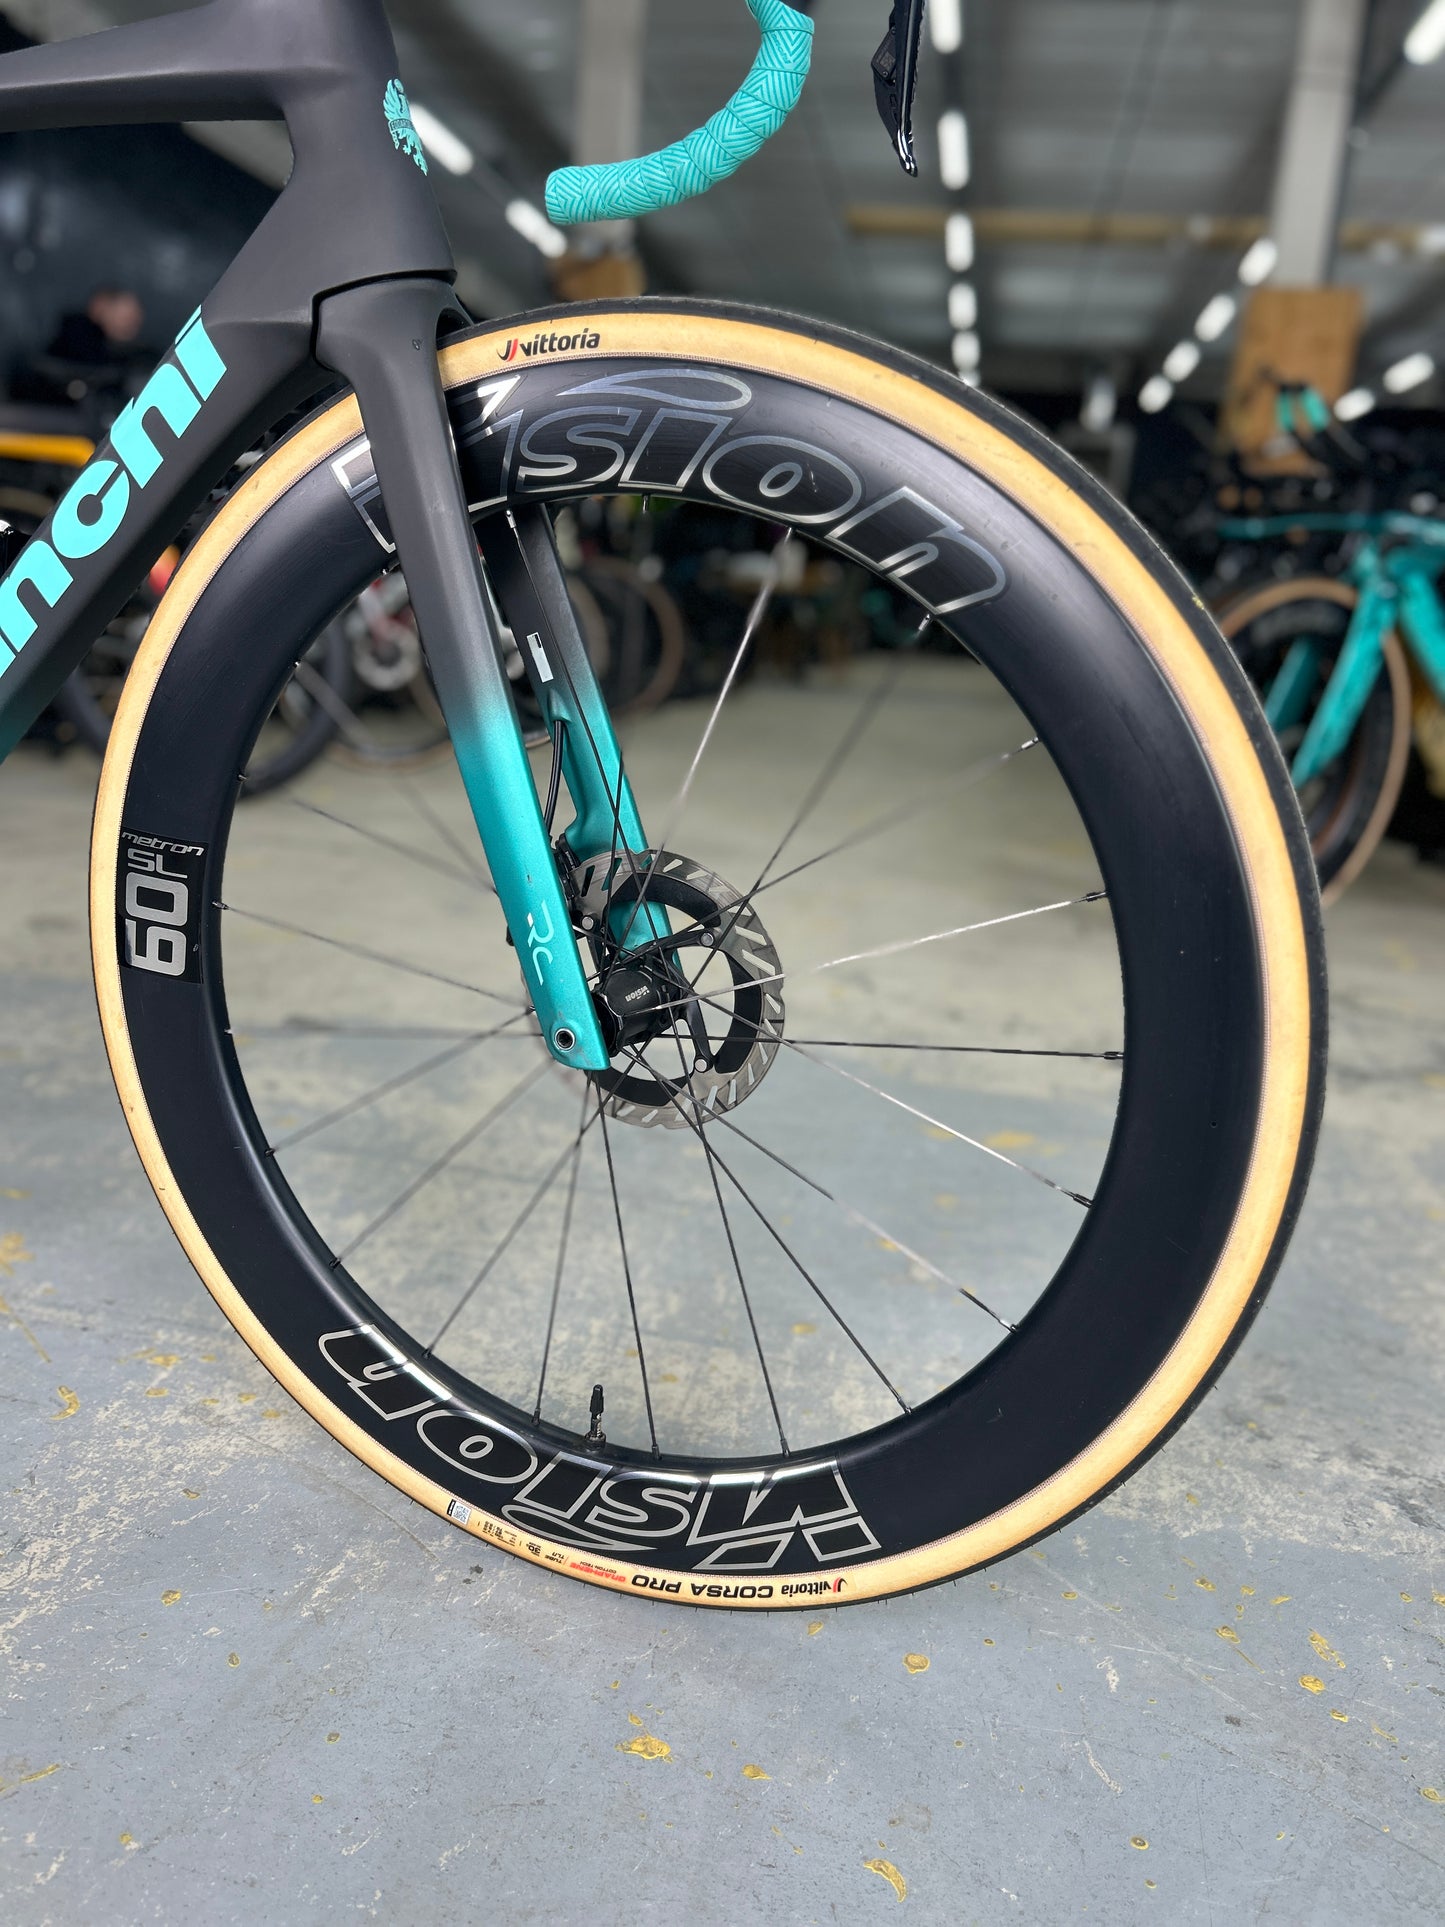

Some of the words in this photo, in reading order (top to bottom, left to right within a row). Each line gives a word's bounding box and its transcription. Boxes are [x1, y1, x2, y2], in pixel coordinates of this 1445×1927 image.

[519, 328, 600, 356] vittoria
[0, 304, 227, 678] nchi
[122, 831, 205, 856] metron
[127, 847, 188, 879] SL
[124, 871, 189, 976] 60
[571, 1562, 626, 1582] GRAPHENE
[631, 1574, 682, 1593] PRO
[690, 1583, 774, 1599] CORSA
[781, 1578, 832, 1596] vittoria
